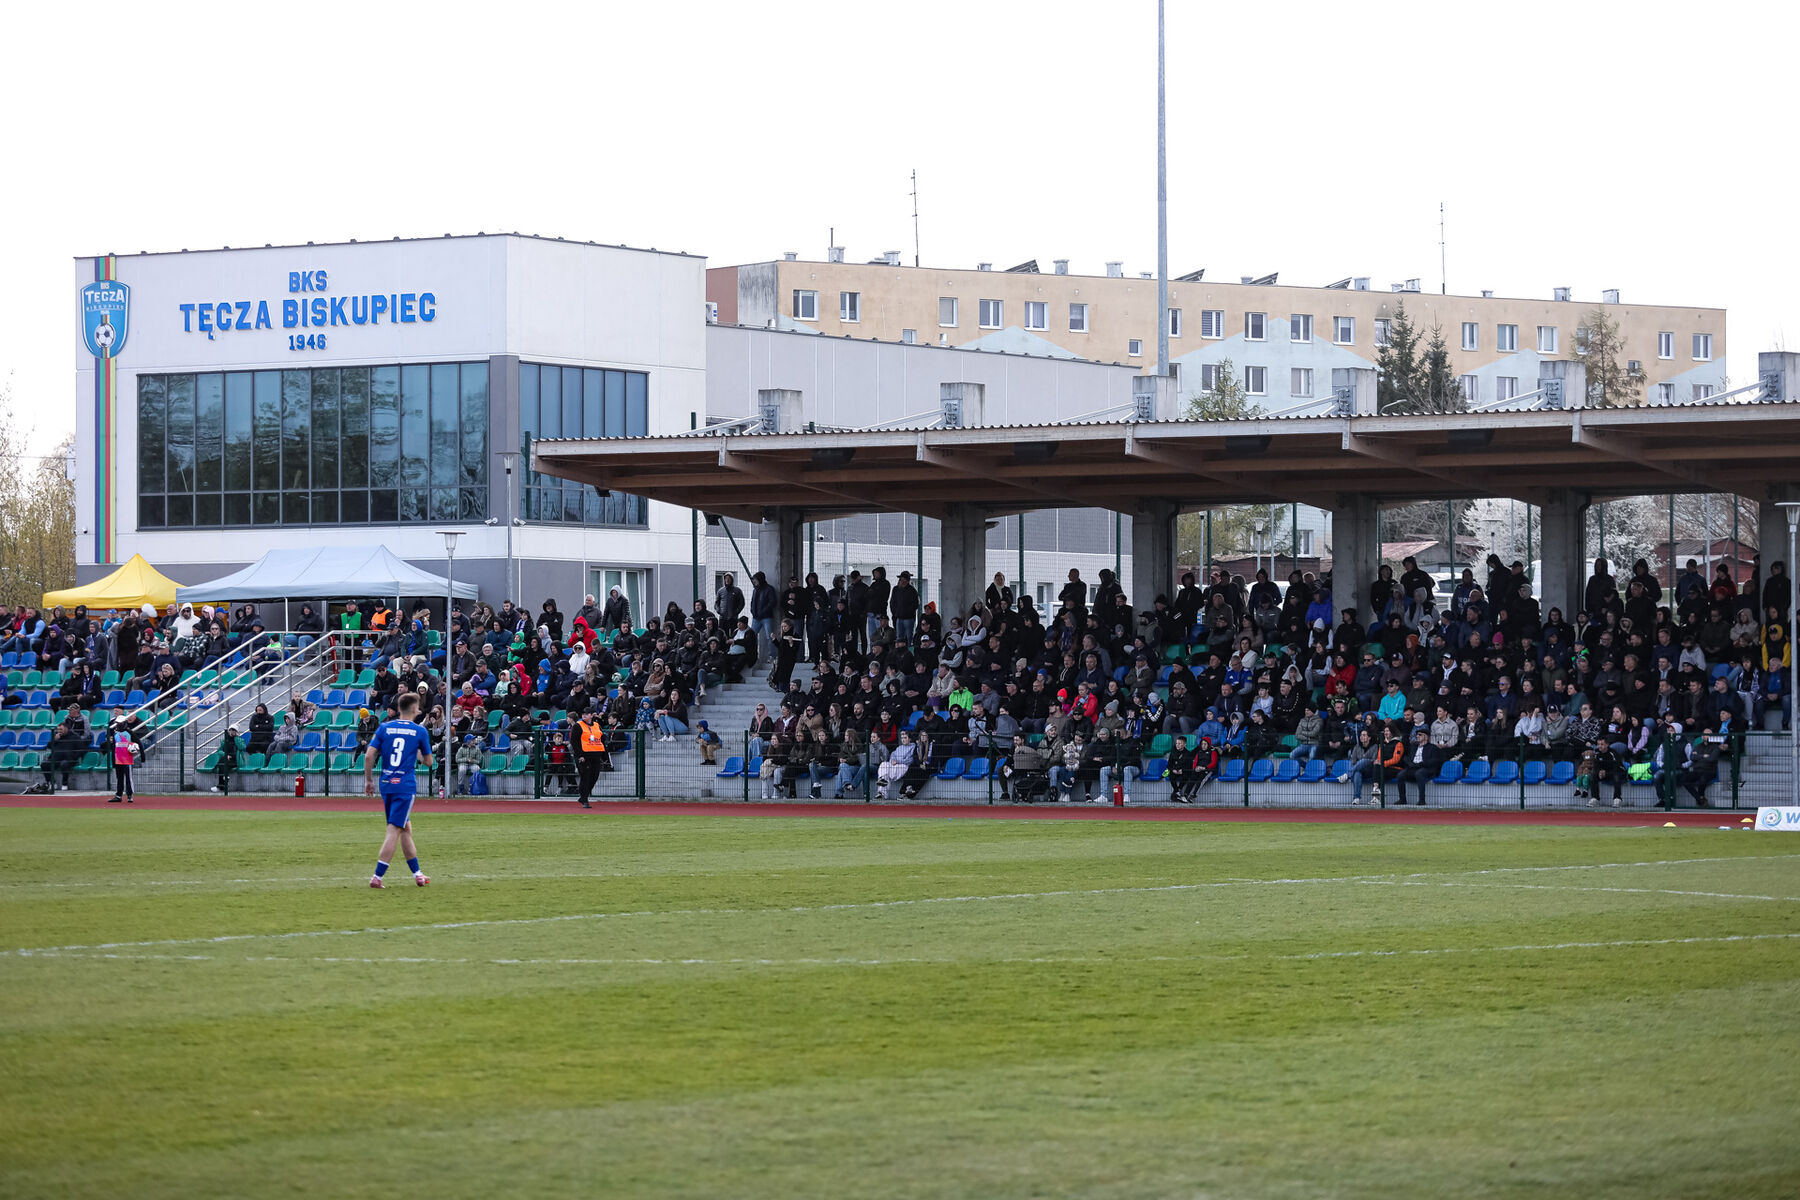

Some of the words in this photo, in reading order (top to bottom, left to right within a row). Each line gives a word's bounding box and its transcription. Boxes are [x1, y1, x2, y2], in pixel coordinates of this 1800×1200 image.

[289, 270, 328, 293] BKS
[180, 300, 272, 340] TĘCZA
[283, 293, 436, 328] BISKUPIEC
[289, 334, 327, 351] 1946
[390, 737, 405, 767] 3
